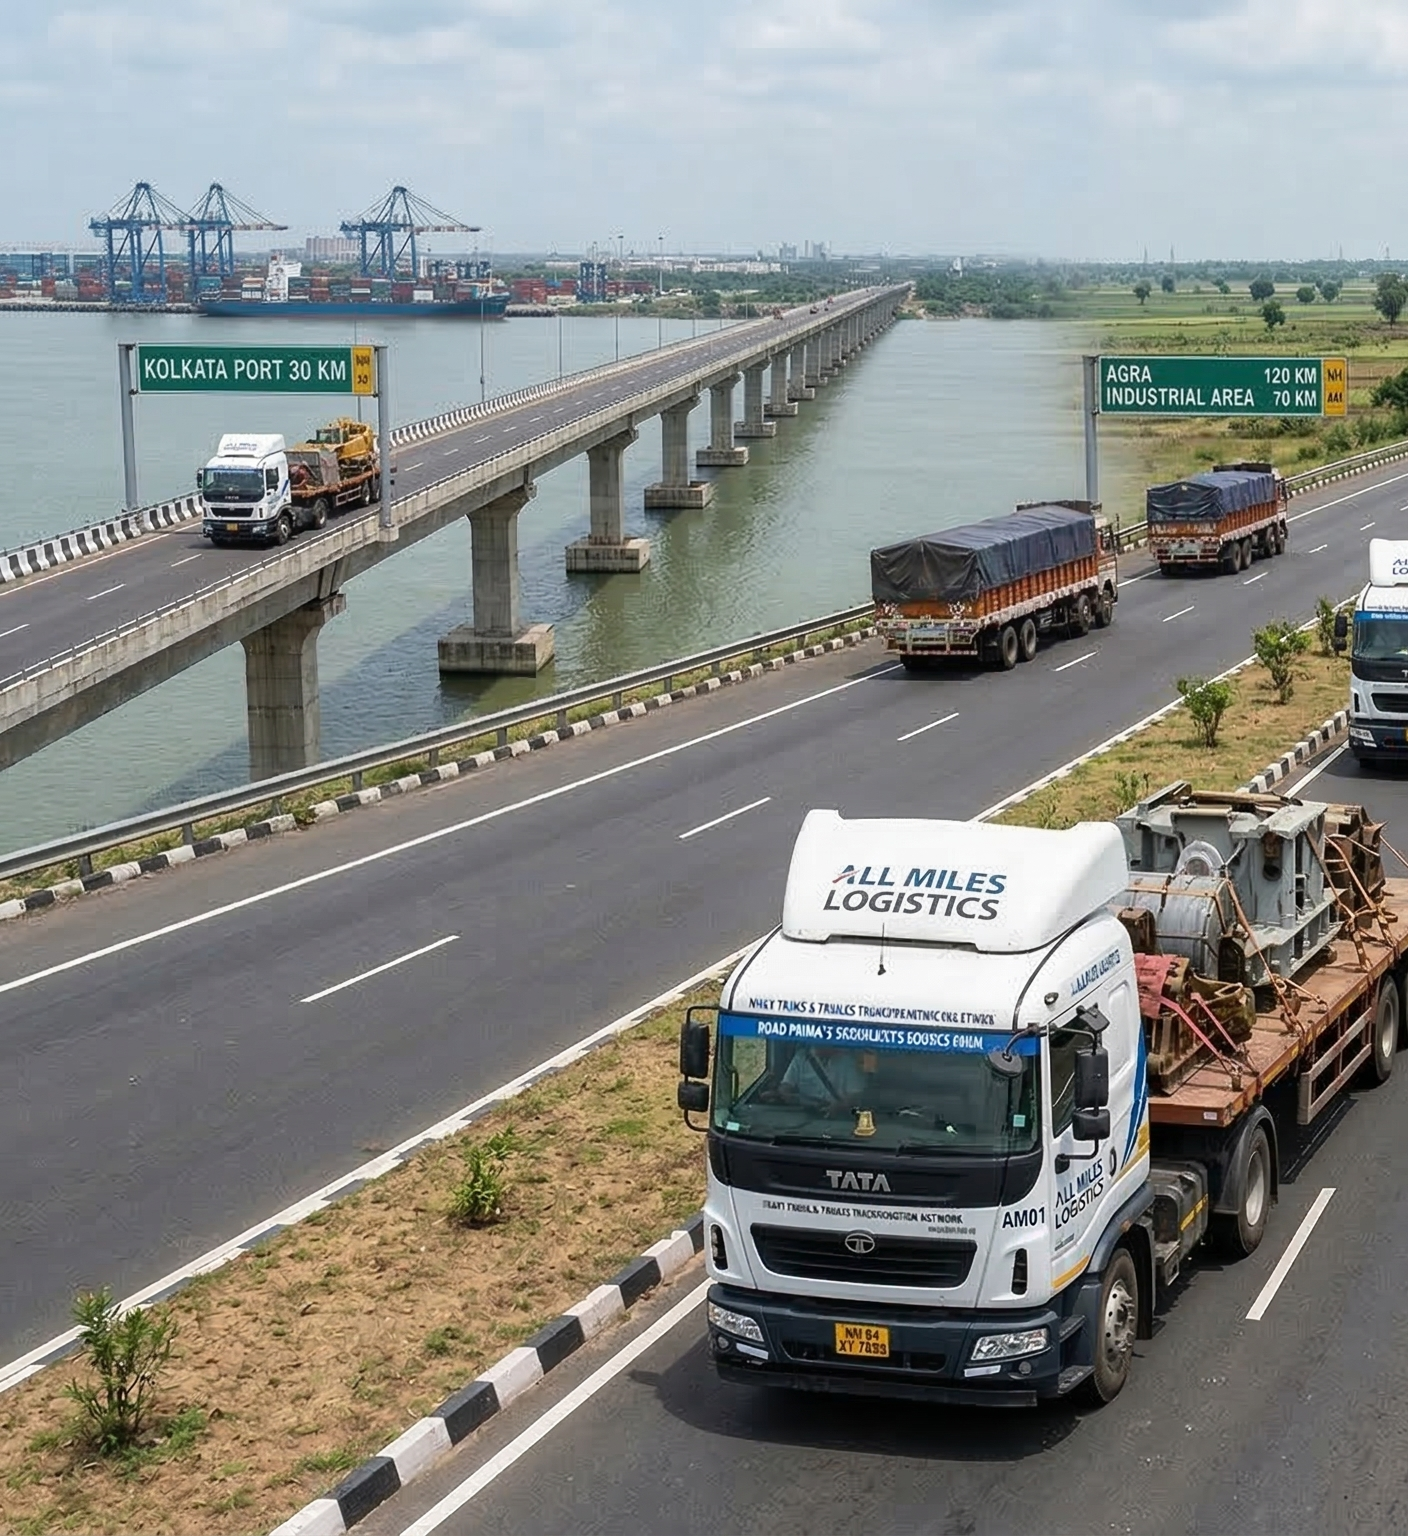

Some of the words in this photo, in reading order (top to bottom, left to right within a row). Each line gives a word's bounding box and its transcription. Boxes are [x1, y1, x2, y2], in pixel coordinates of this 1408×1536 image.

[144, 358, 228, 380] KOLKATA
[234, 359, 284, 381] PORT
[289, 360, 312, 380] 30
[318, 360, 346, 381] KM
[1106, 364, 1152, 383] AGRA
[1264, 367, 1290, 384] 120
[1295, 367, 1317, 384] KM
[1106, 387, 1206, 406] INDUSTRIAL
[1210, 388, 1255, 407] AREA
[1273, 390, 1290, 407] 70
[1295, 390, 1317, 407] KM
[832, 864, 894, 886] ALL
[903, 868, 1007, 895] MILES
[823, 889, 1000, 921] LOGISTICS
[757, 1021, 787, 1036] ROAD
[826, 1169, 891, 1192] TATA
[1055, 1182, 1076, 1208] ALL
[1002, 1206, 1045, 1229] AM01
[839, 1340, 854, 1352] XY
